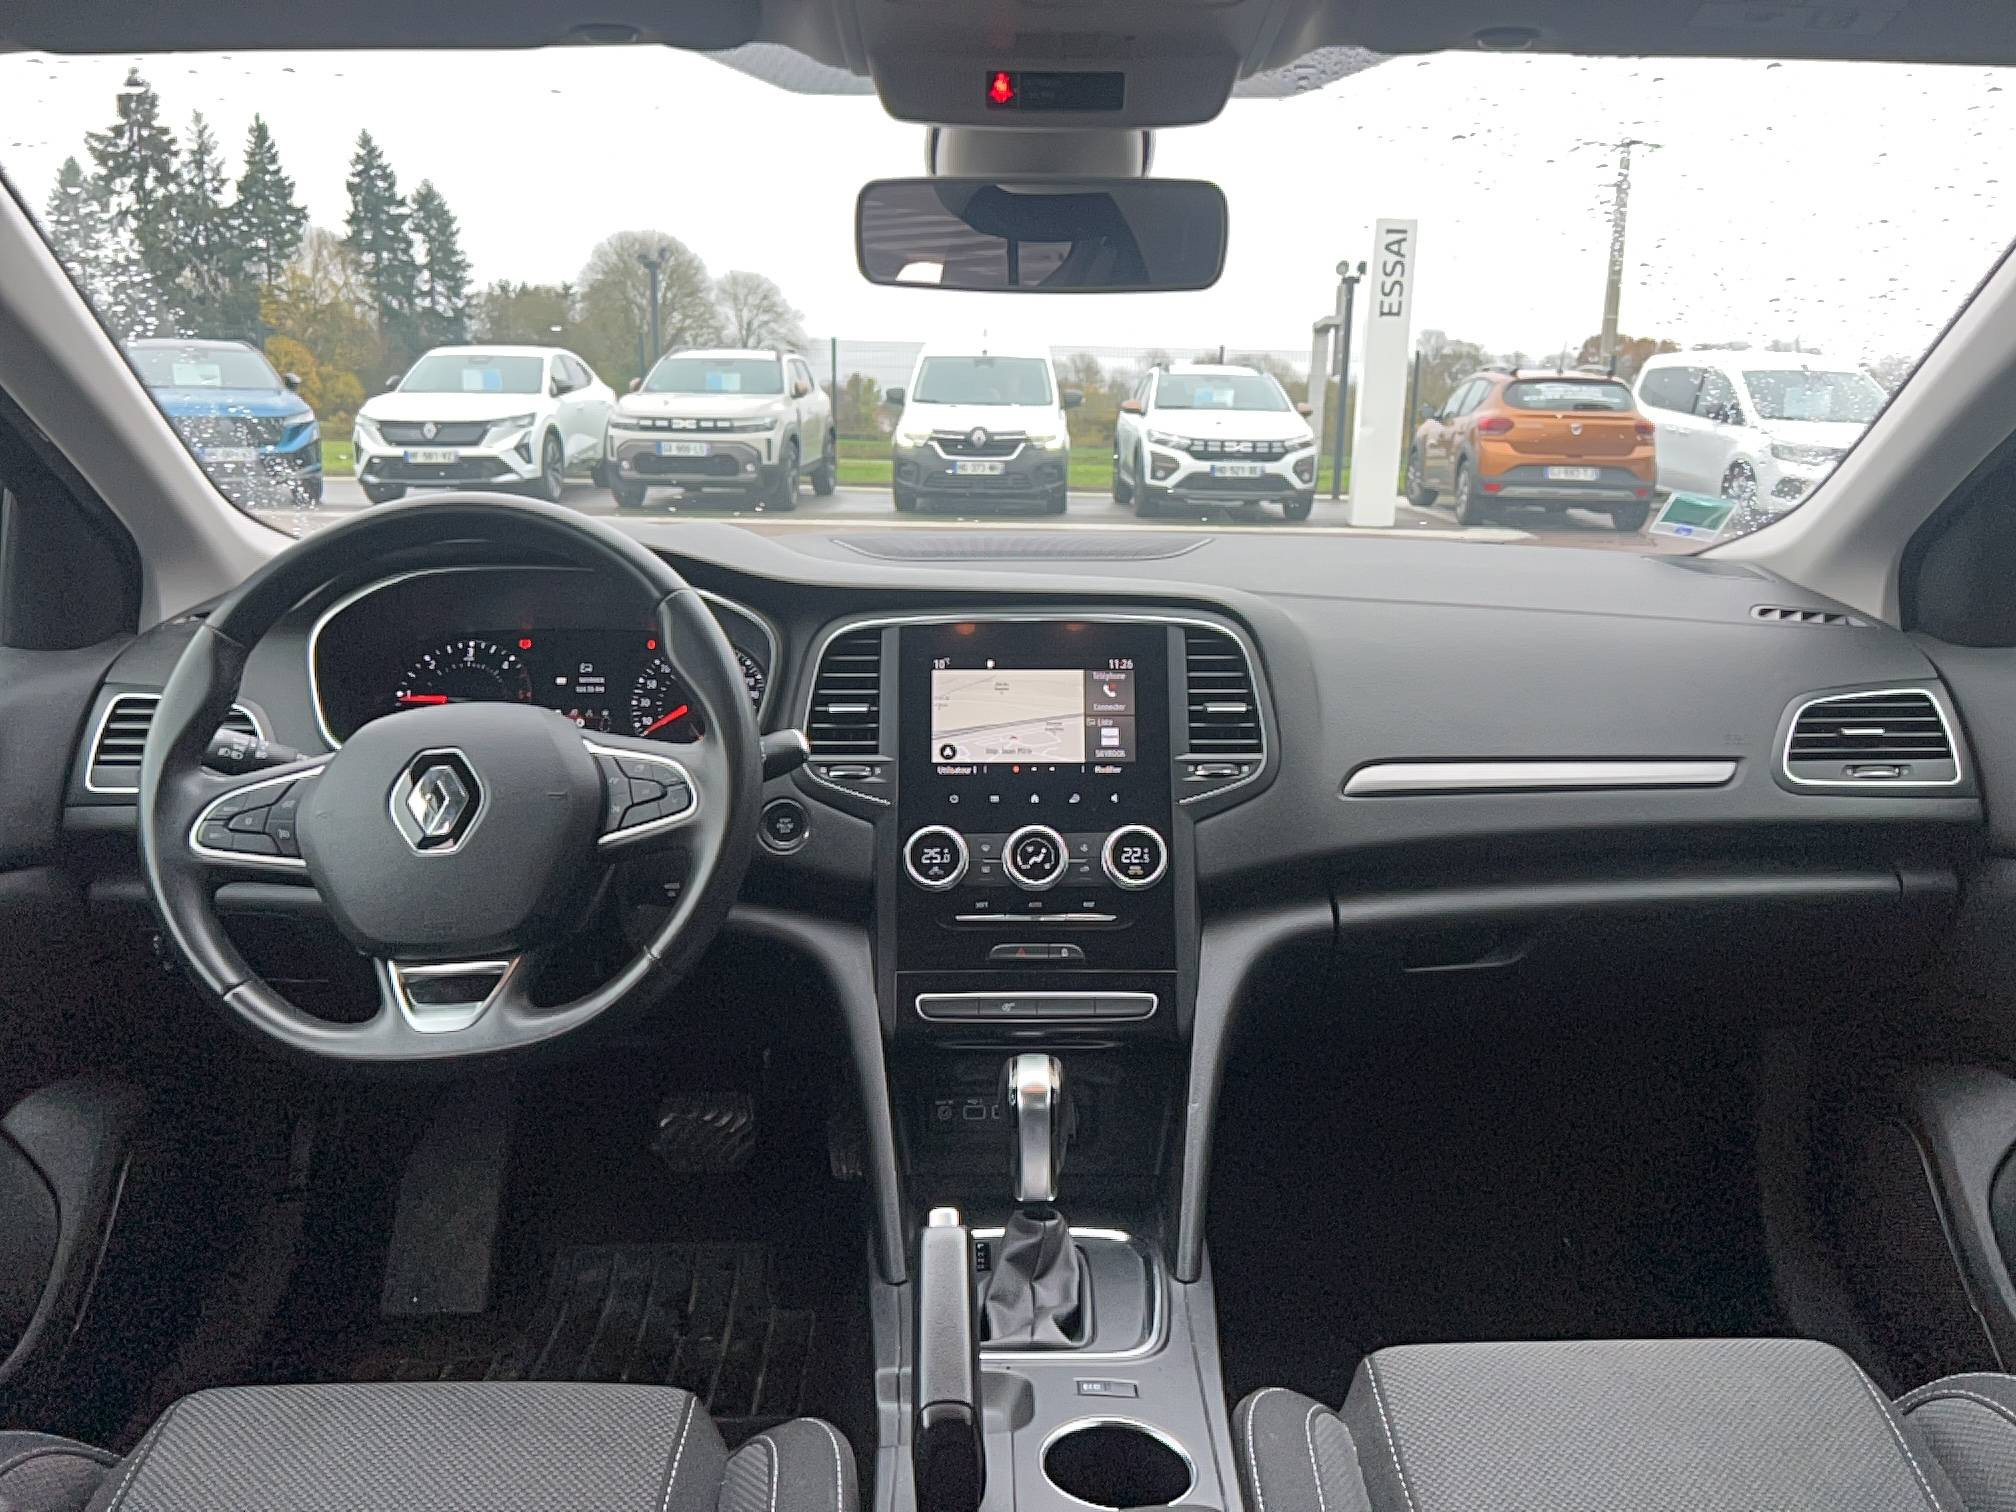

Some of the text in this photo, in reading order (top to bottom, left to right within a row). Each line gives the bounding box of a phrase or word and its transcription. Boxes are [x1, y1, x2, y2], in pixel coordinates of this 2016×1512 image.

[1379, 227, 1408, 317] ESSAI
[1108, 658, 1134, 669] 11:26
[1121, 847, 1150, 863] 22.5
